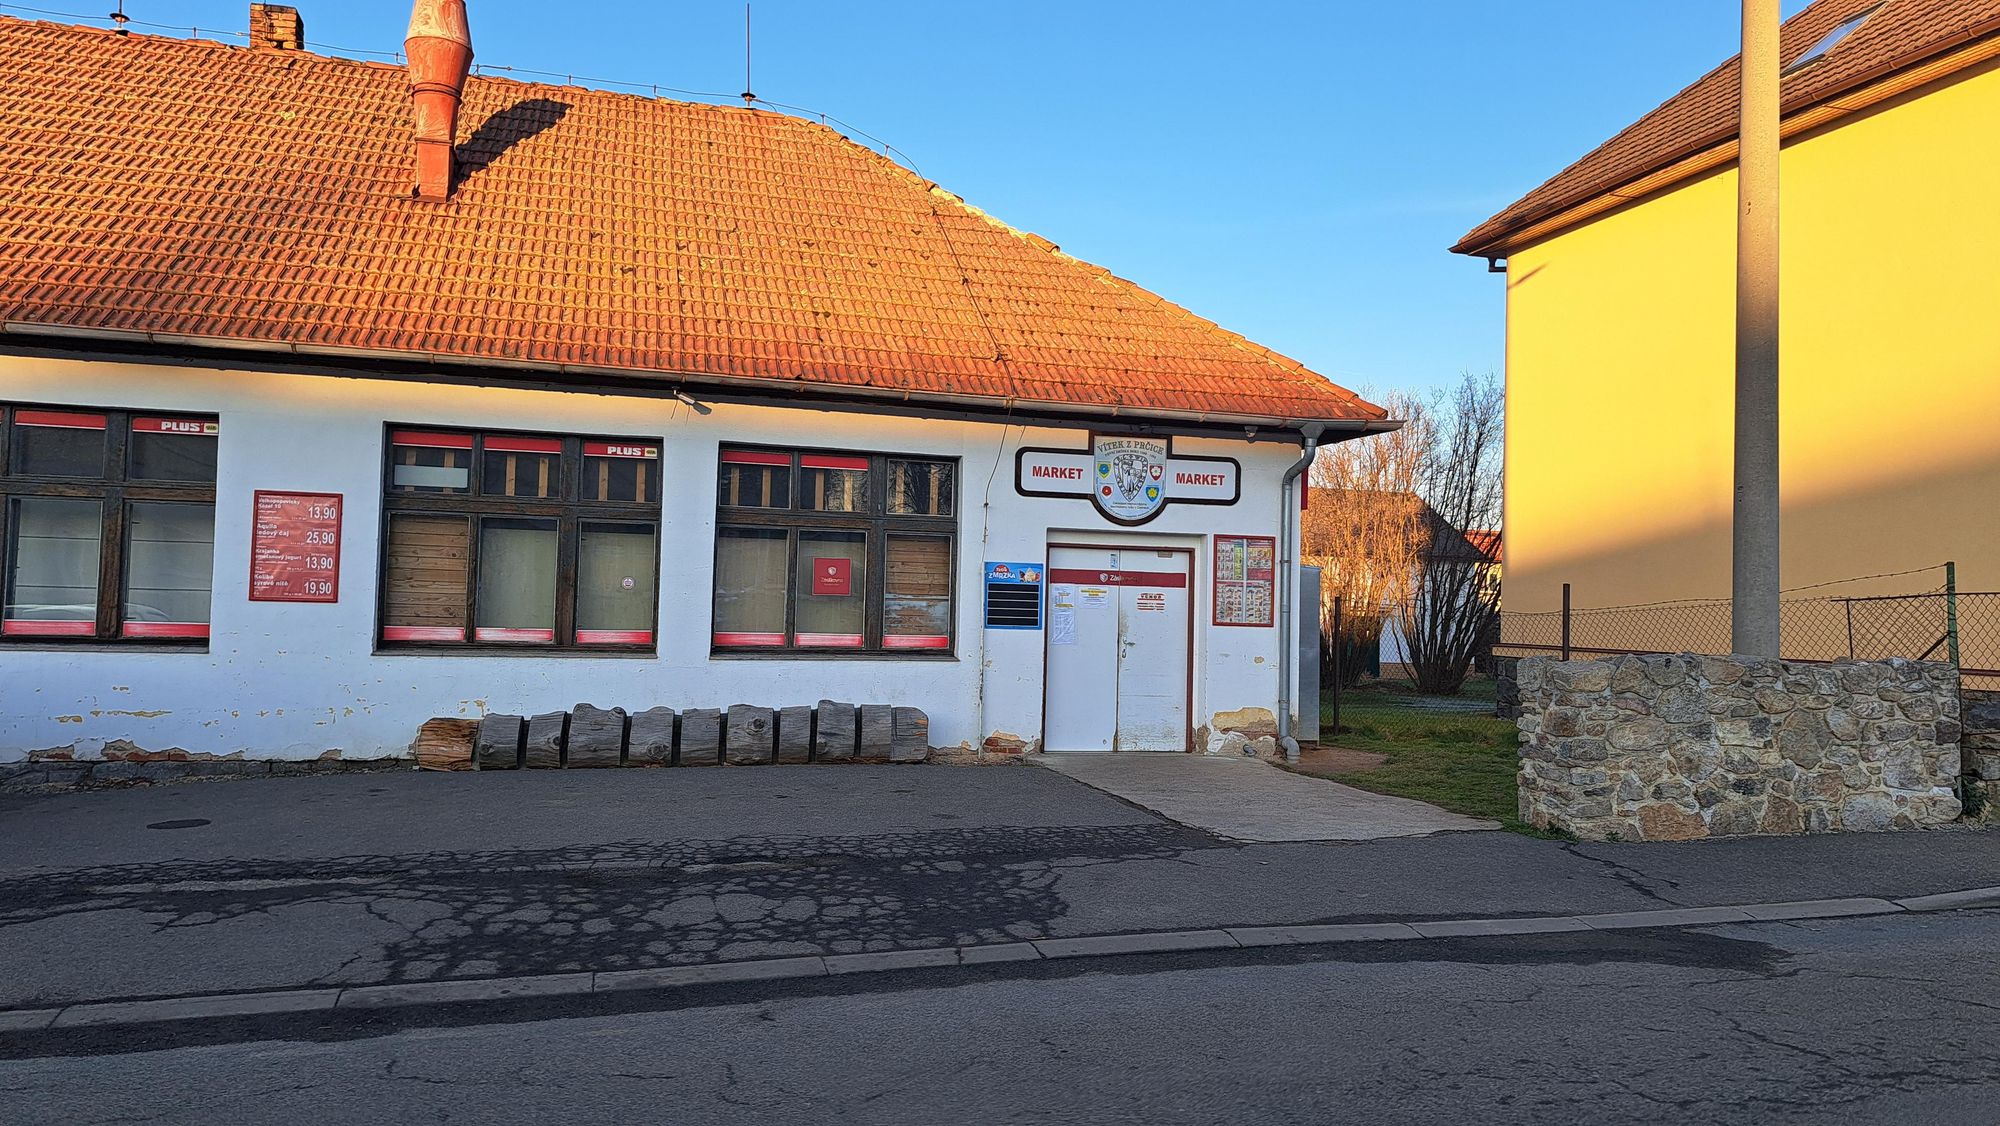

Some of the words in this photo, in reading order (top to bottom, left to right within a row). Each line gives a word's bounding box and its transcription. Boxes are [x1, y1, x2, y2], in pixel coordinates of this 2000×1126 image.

[161, 421, 200, 431] PLUS
[607, 446, 642, 455] PLUS
[1096, 441, 1125, 453] VÍTEK
[1134, 441, 1165, 455] PRČICE
[1032, 466, 1083, 479] MARKET
[1176, 473, 1225, 486] MARKET
[308, 507, 336, 520] 13,90
[306, 531, 335, 546] 25,90
[305, 556, 333, 570] 13,90
[988, 571, 1016, 579] ZMRZKA
[303, 582, 332, 595] 19,90
